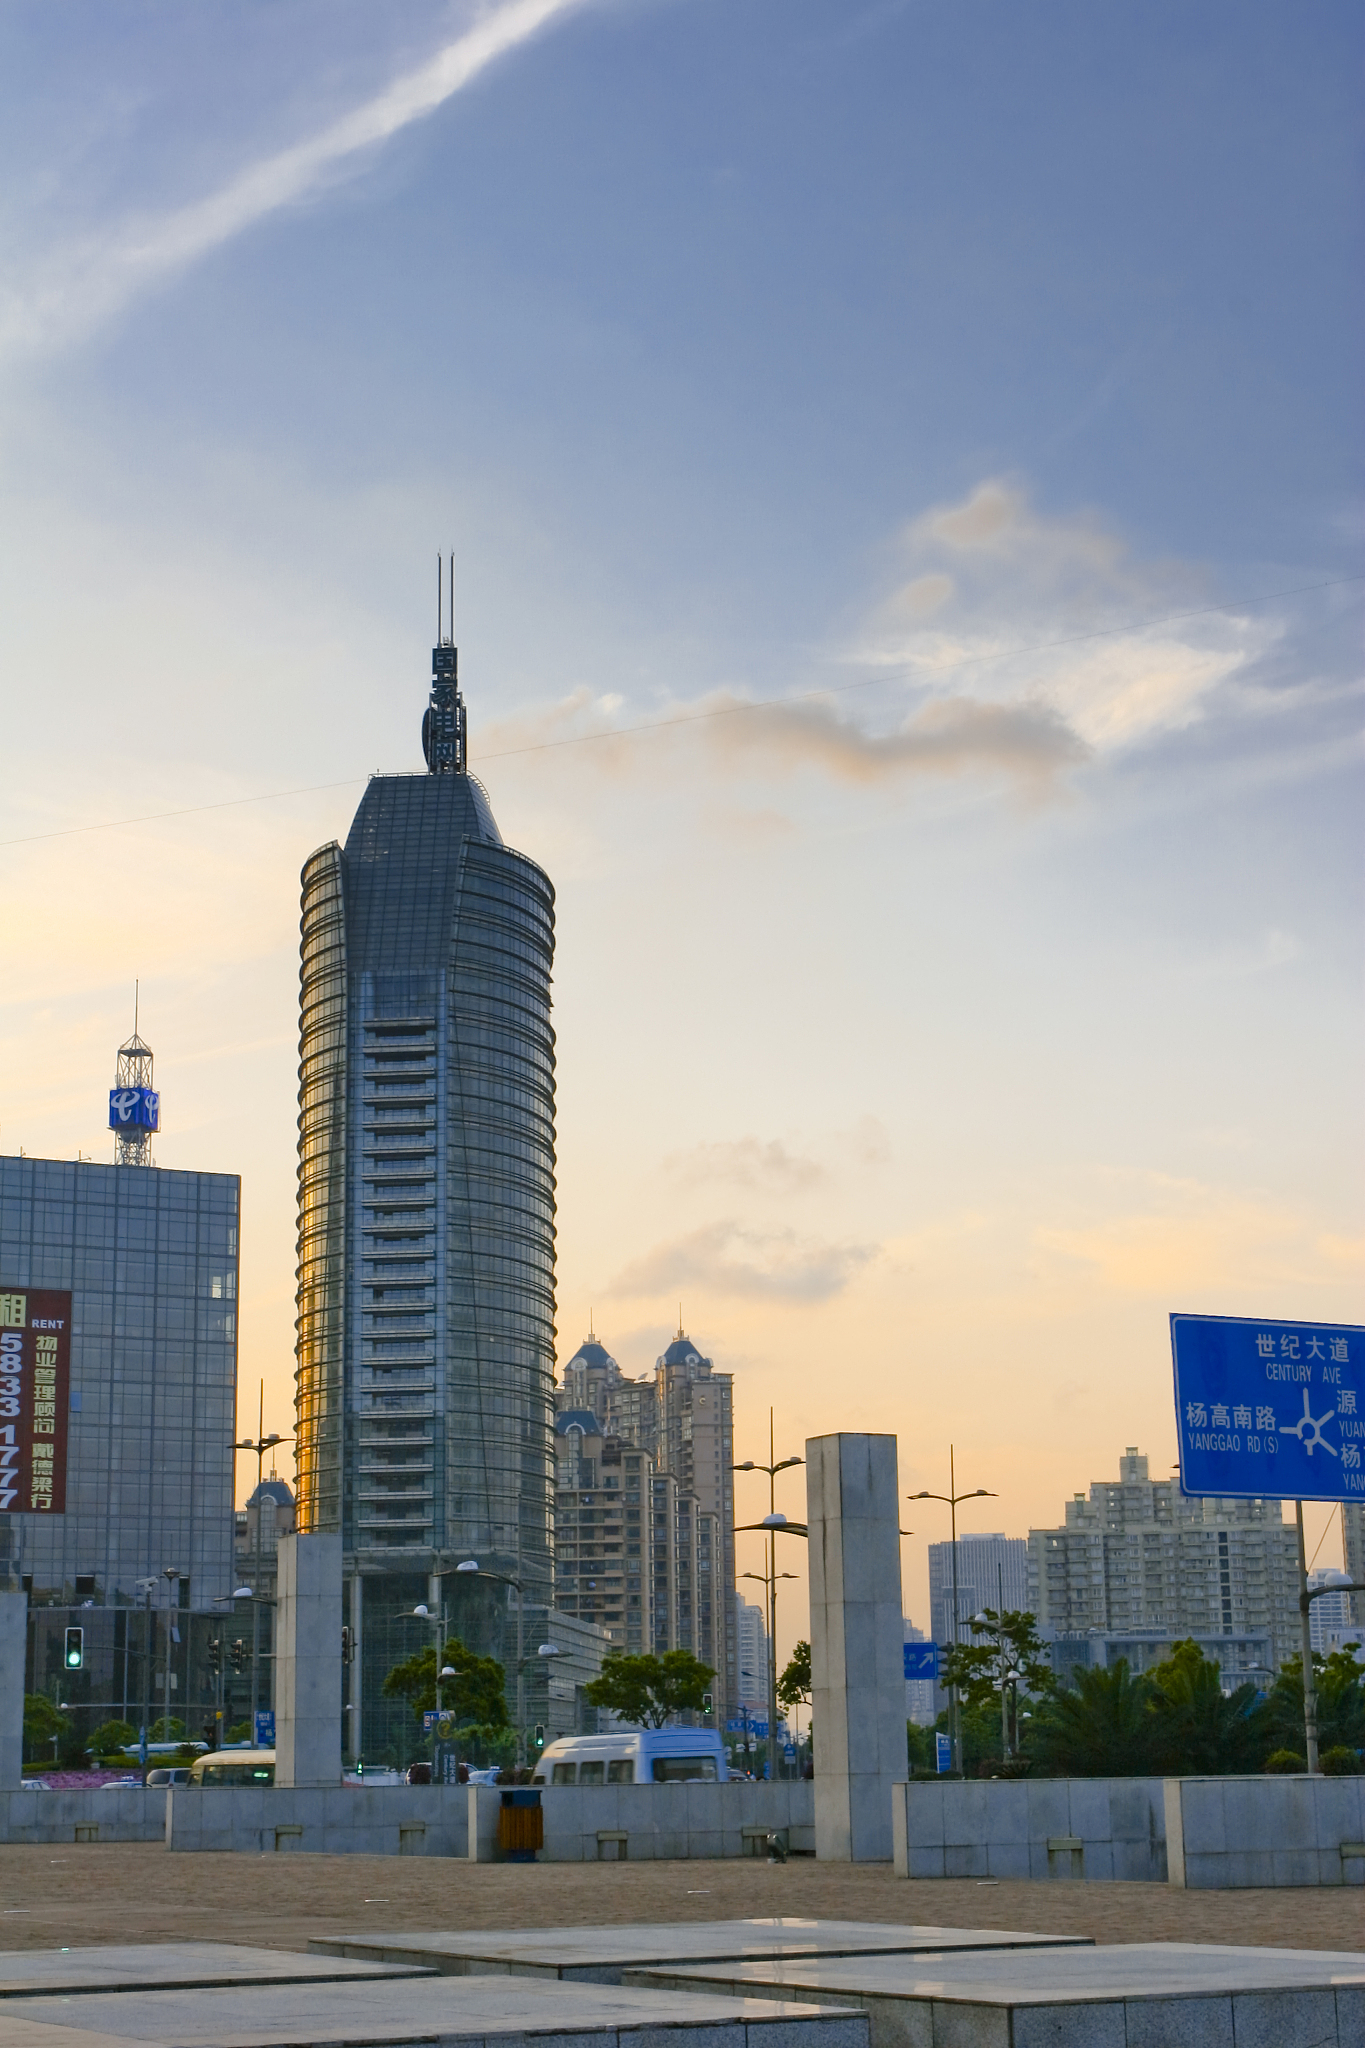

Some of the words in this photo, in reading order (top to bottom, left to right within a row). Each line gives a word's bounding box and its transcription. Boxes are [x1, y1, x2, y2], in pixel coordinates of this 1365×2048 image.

[32, 1319, 64, 1329] RENT
[1255, 1333, 1349, 1362] 世纪大道
[33, 1335, 57, 1434] 物业管理顾问
[1266, 1363, 1312, 1382] CENTURY
[1322, 1367, 1341, 1384] AVE
[1337, 1390, 1357, 1414] 源
[1186, 1402, 1276, 1431] 杨高南路
[1188, 1433, 1241, 1452] YANGGAO
[1340, 1443, 1365, 1468] 杨
[30, 1443, 54, 1509] 戴德梁行
